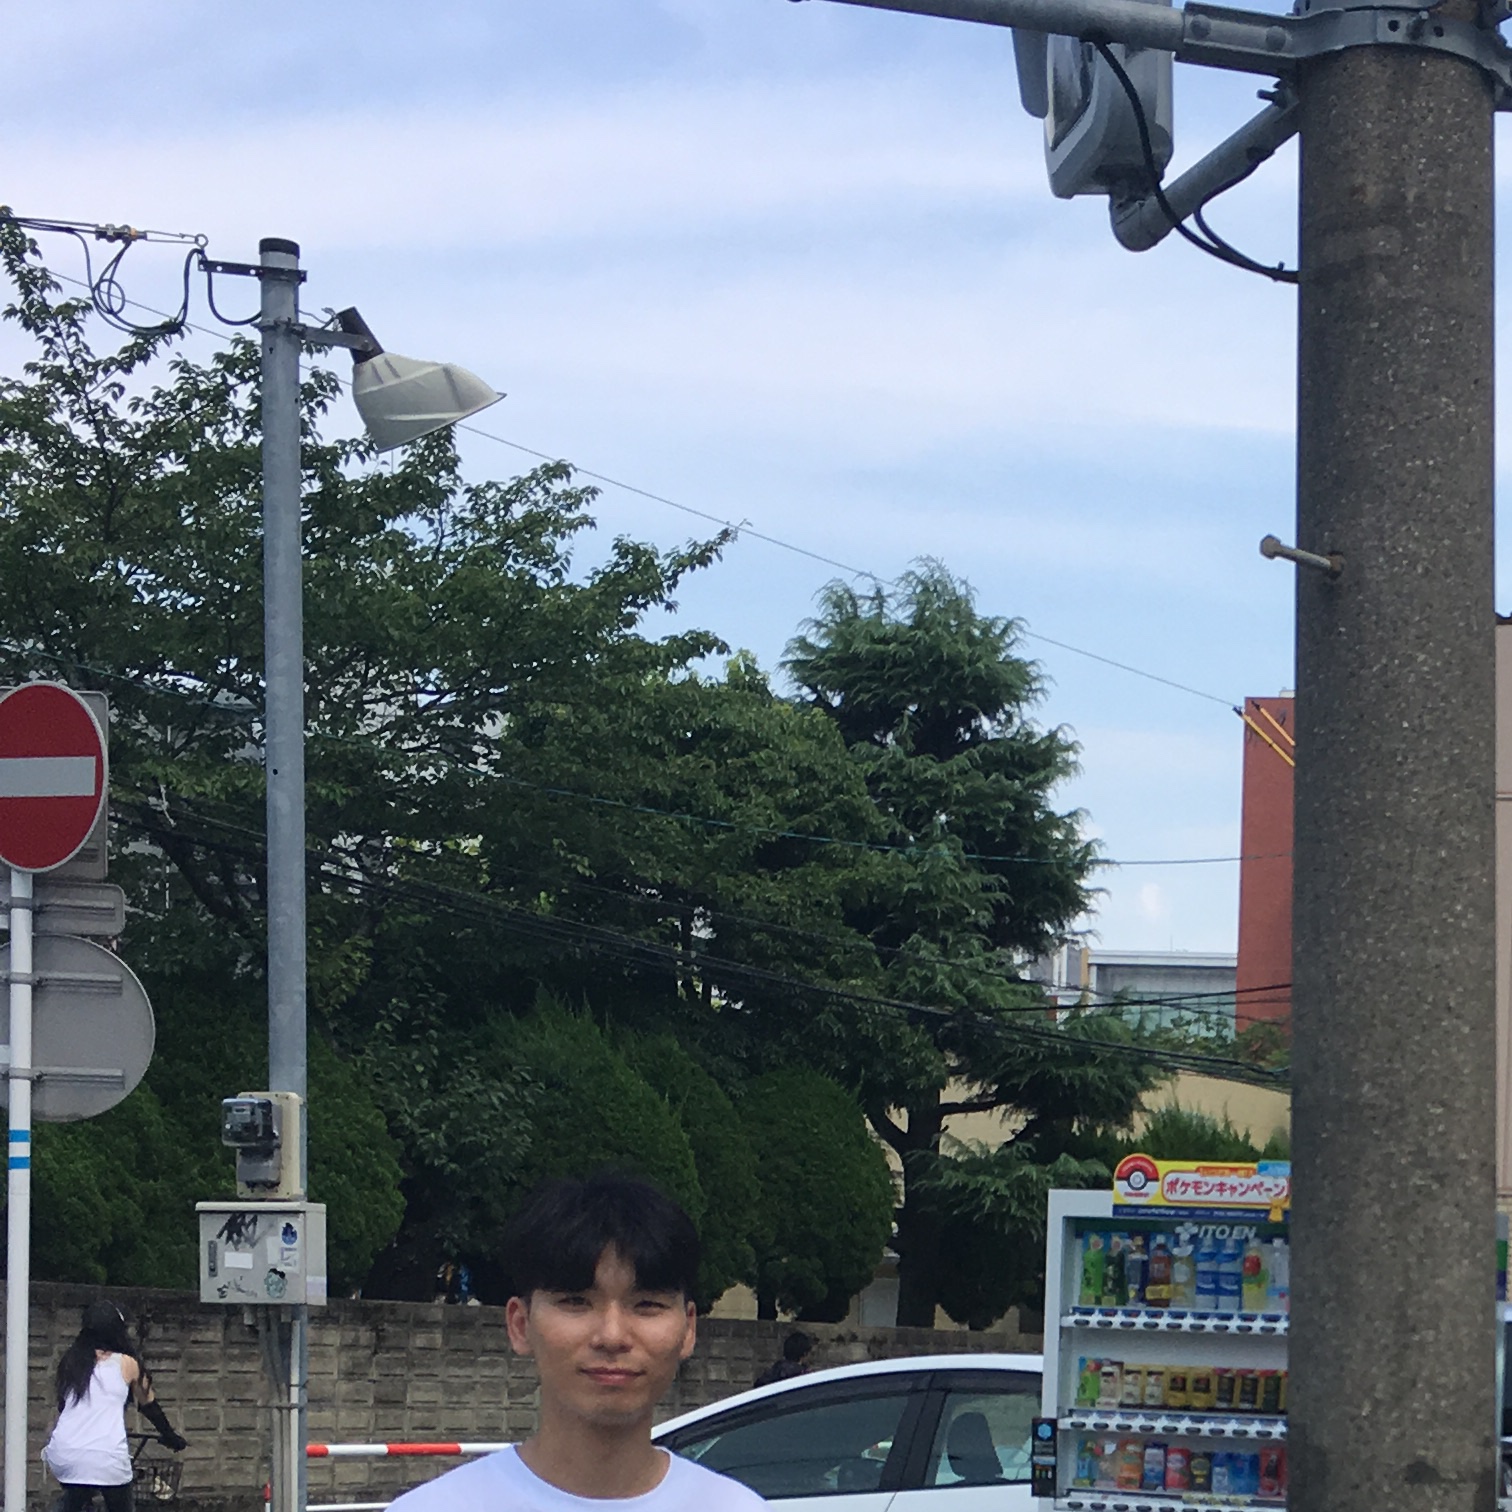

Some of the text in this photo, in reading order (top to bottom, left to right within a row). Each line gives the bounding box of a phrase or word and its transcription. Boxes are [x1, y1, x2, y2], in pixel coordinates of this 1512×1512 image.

[1166, 1177, 1286, 1198] ポケモンキャンペーン
